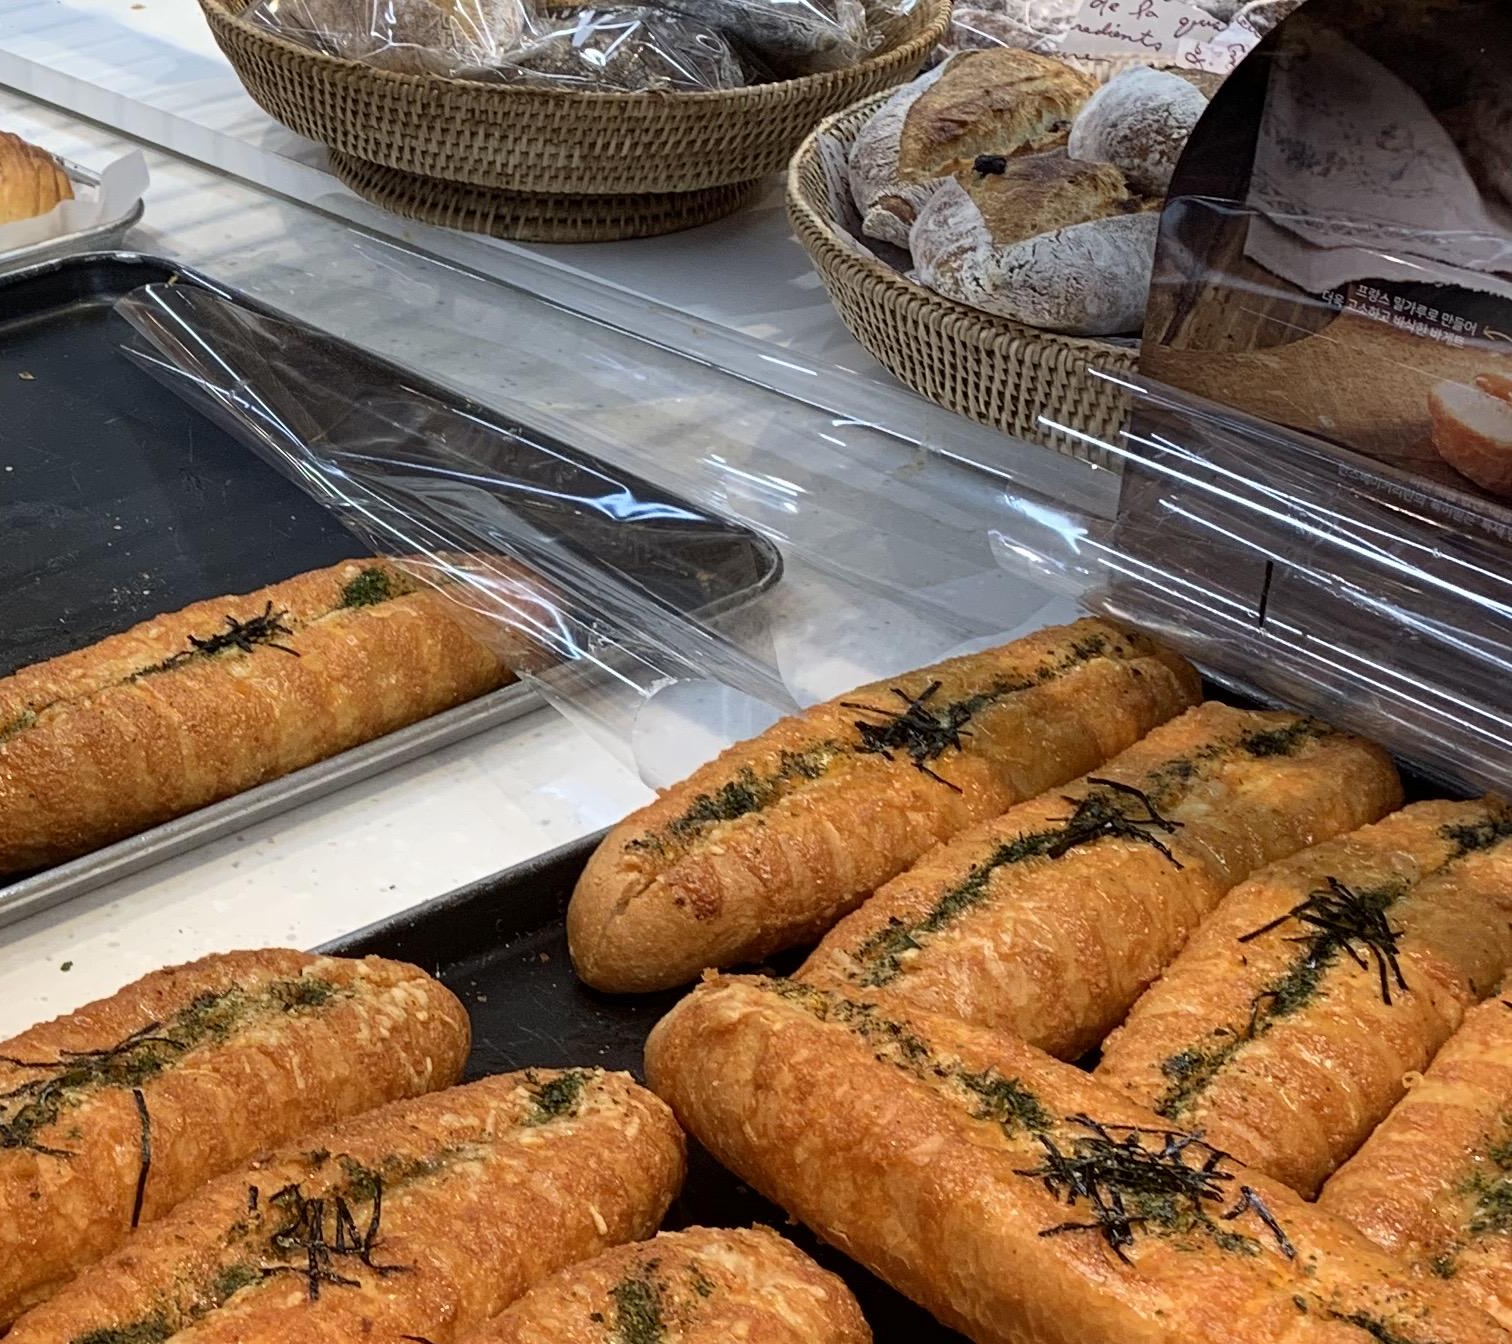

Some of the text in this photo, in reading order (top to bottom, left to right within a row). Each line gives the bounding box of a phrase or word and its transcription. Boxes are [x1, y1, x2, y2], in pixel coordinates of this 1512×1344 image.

[1355, 284, 1478, 337] 프랑스 밀가루로 만들어
